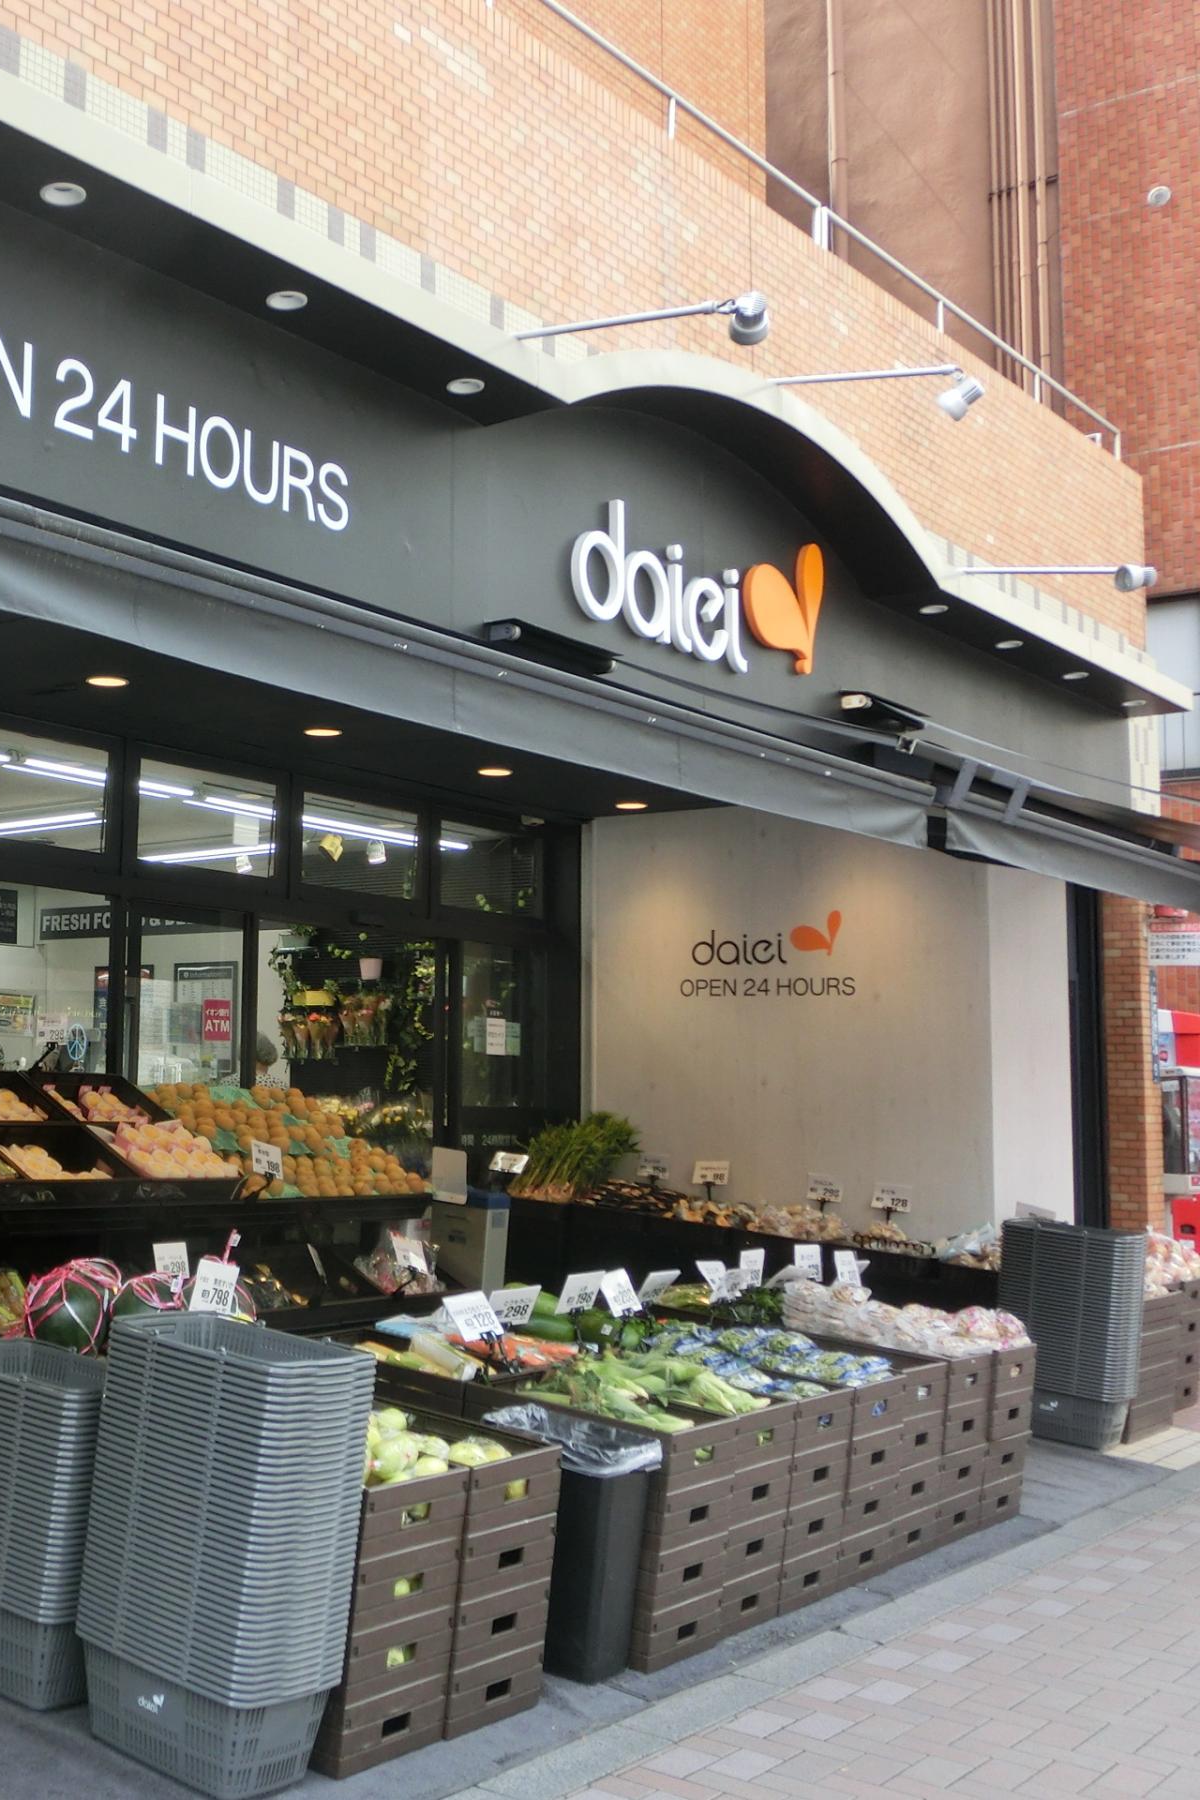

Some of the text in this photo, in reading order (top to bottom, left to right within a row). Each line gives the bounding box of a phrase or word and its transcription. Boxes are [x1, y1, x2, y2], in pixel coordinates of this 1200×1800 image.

[53, 358, 137, 453] 24
[155, 393, 350, 532] HOURS
[571, 499, 748, 674] daiei
[42, 913, 91, 931] FRESH
[692, 930, 787, 965] daiei
[680, 977, 856, 997] OPEN 24 HOURS
[205, 1019, 230, 1032] ATM
[170, 1261, 186, 1273] 298
[210, 1288, 230, 1307] 798
[473, 1311, 495, 1327] 128
[504, 1304, 529, 1319] 298
